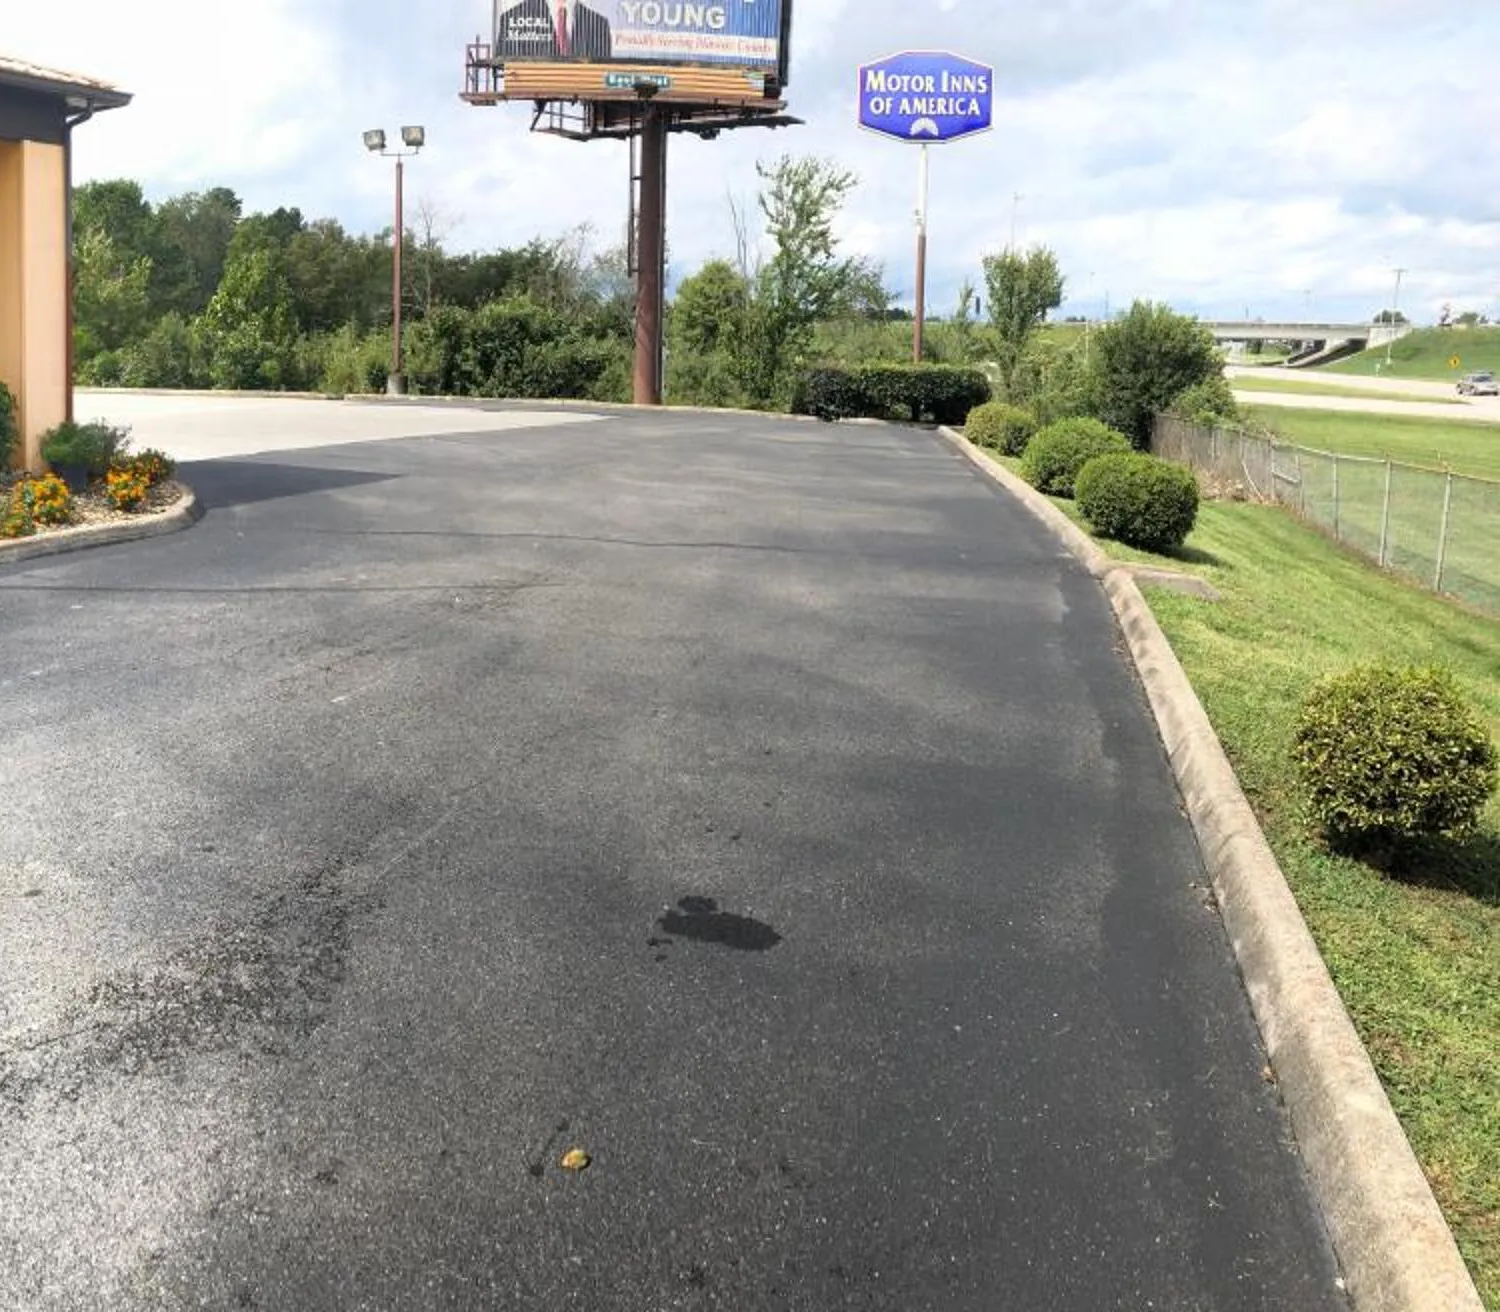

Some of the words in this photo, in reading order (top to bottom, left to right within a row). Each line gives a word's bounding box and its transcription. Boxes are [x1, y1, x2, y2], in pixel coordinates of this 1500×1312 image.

[509, 17, 551, 27] LOCAL
[621, 3, 725, 29] YOUNG
[866, 70, 935, 93] MOTOR
[942, 70, 988, 93] INNS
[870, 97, 893, 115] OF
[899, 97, 981, 115] AMERICA
